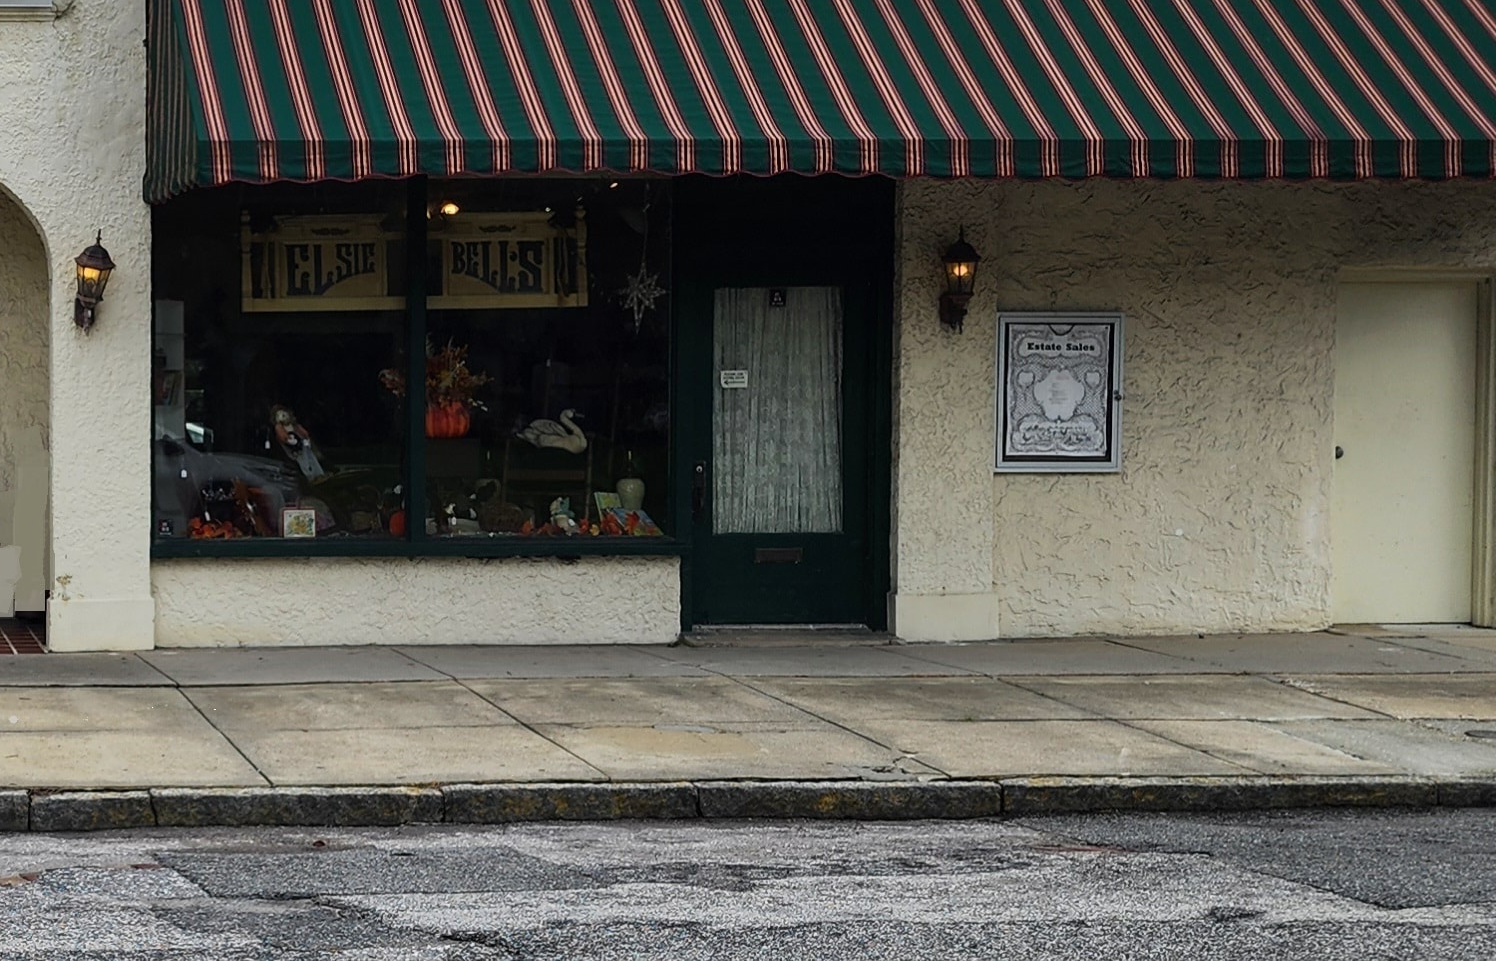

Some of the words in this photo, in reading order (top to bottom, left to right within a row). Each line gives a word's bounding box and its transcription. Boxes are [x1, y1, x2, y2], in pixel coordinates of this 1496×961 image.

[285, 242, 376, 296] ELSIE
[450, 241, 545, 294] BELL'S
[1028, 343, 1062, 351] Estate
[1066, 344, 1095, 352] Sales
